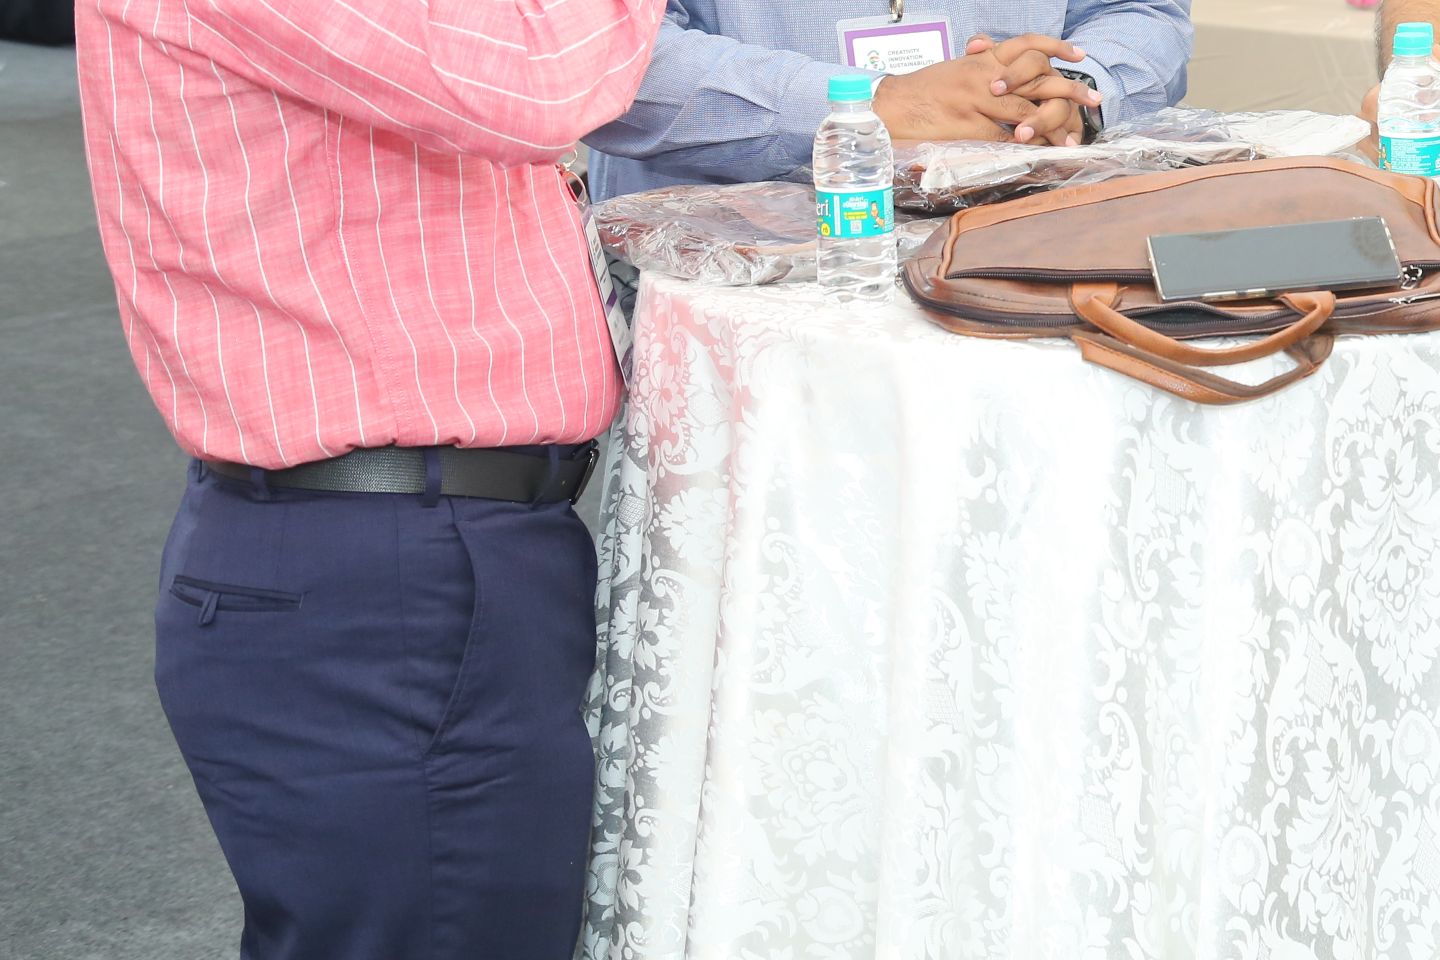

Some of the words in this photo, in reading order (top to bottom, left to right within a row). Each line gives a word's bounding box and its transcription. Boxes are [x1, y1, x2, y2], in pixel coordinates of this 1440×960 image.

[888, 48, 920, 56] CREATIVITY
[888, 54, 923, 62] INNOVATION
[889, 59, 935, 69] SUSTAINABILITY
